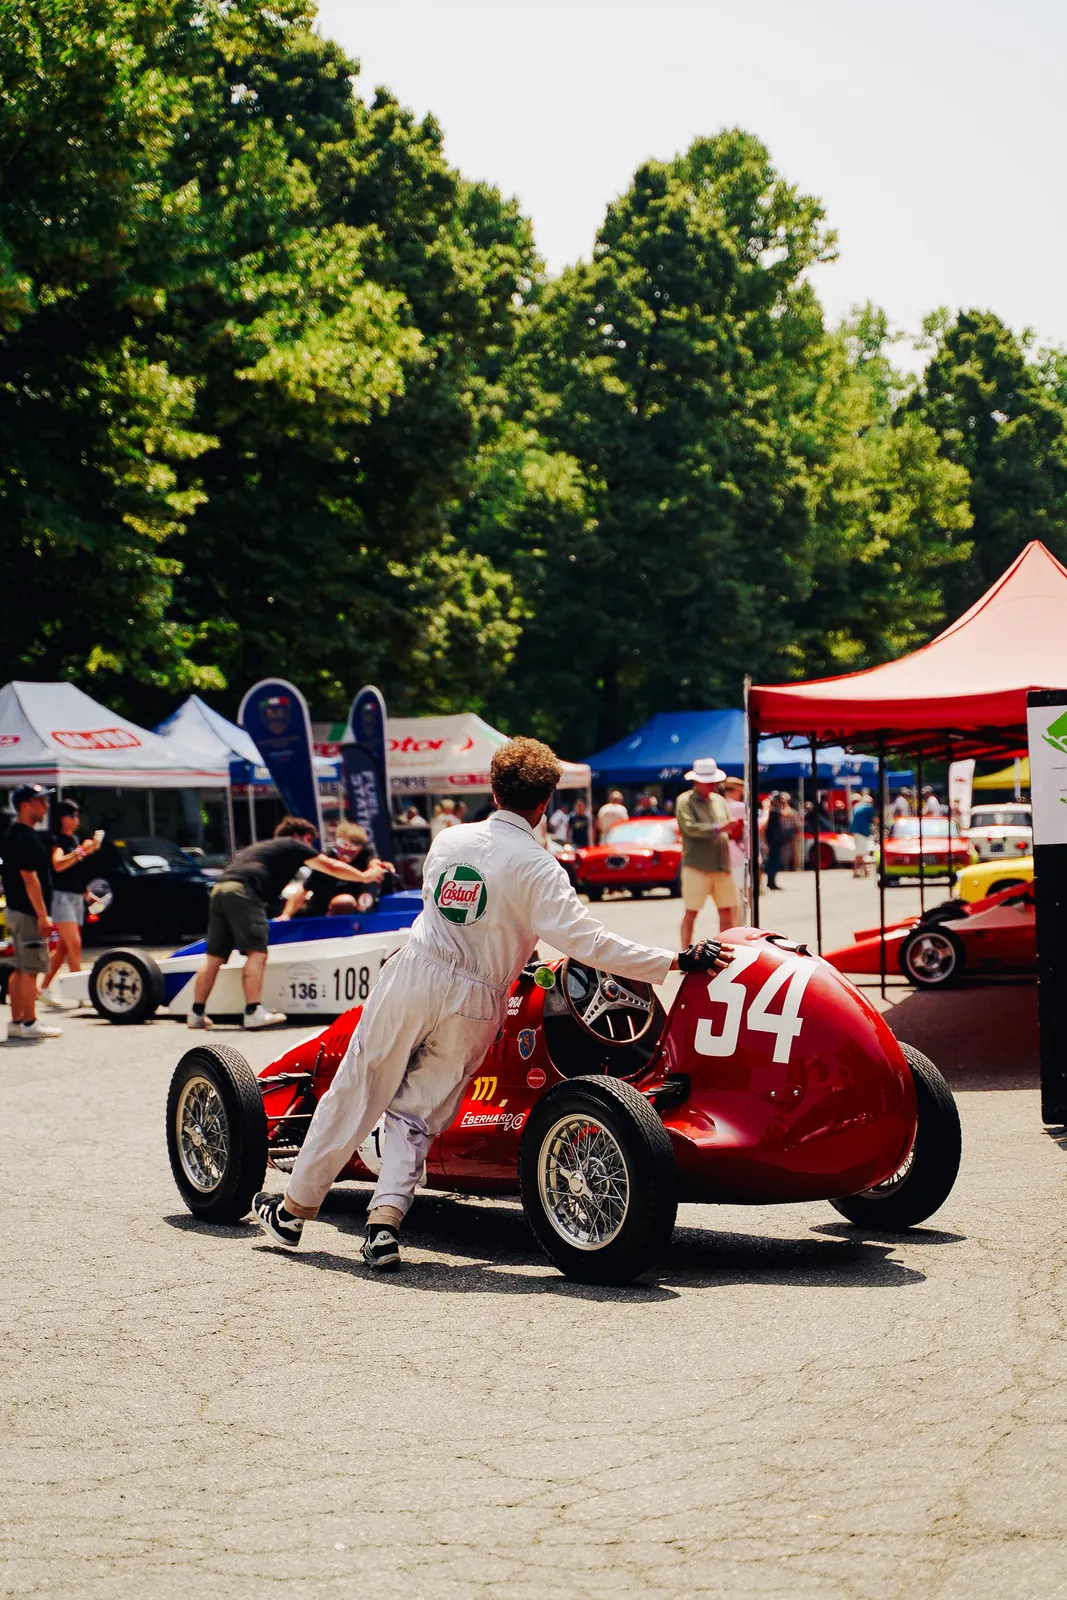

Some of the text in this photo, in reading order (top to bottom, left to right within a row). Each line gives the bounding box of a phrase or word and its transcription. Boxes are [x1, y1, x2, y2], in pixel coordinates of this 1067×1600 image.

[440, 880, 480, 906] Castrol
[289, 983, 317, 999] 136
[333, 966, 369, 1000] 108
[694, 943, 819, 1064] 34
[471, 1076, 498, 1100] 177
